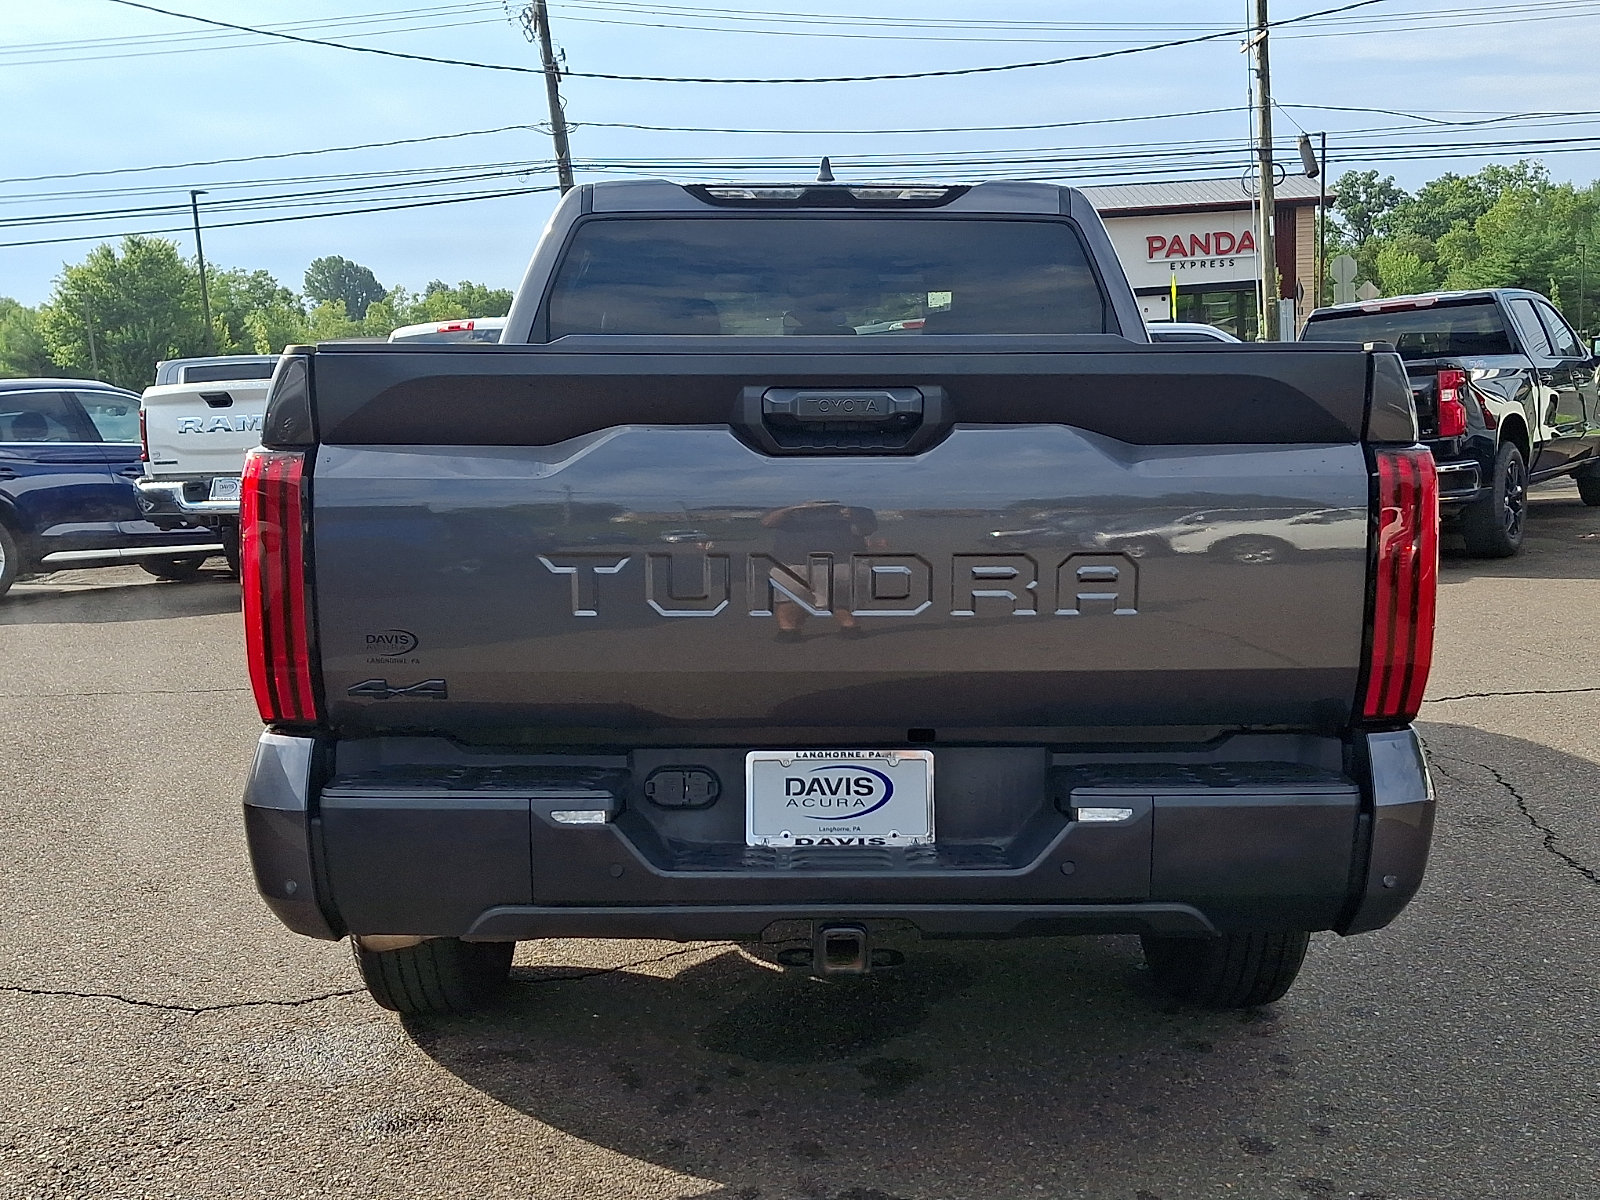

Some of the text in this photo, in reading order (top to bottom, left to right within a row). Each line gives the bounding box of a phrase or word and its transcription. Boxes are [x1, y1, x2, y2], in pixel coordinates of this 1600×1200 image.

[1146, 231, 1258, 259] PANDA
[1170, 259, 1235, 270] EXPRESS
[806, 399, 879, 412] TOYOTA
[177, 414, 264, 434] RAM
[537, 551, 1140, 617] TUNDRA
[366, 634, 409, 645] DAVIS
[785, 777, 875, 796] DAVIS
[786, 798, 866, 807] ACURA
[795, 837, 887, 845] DAVIS
